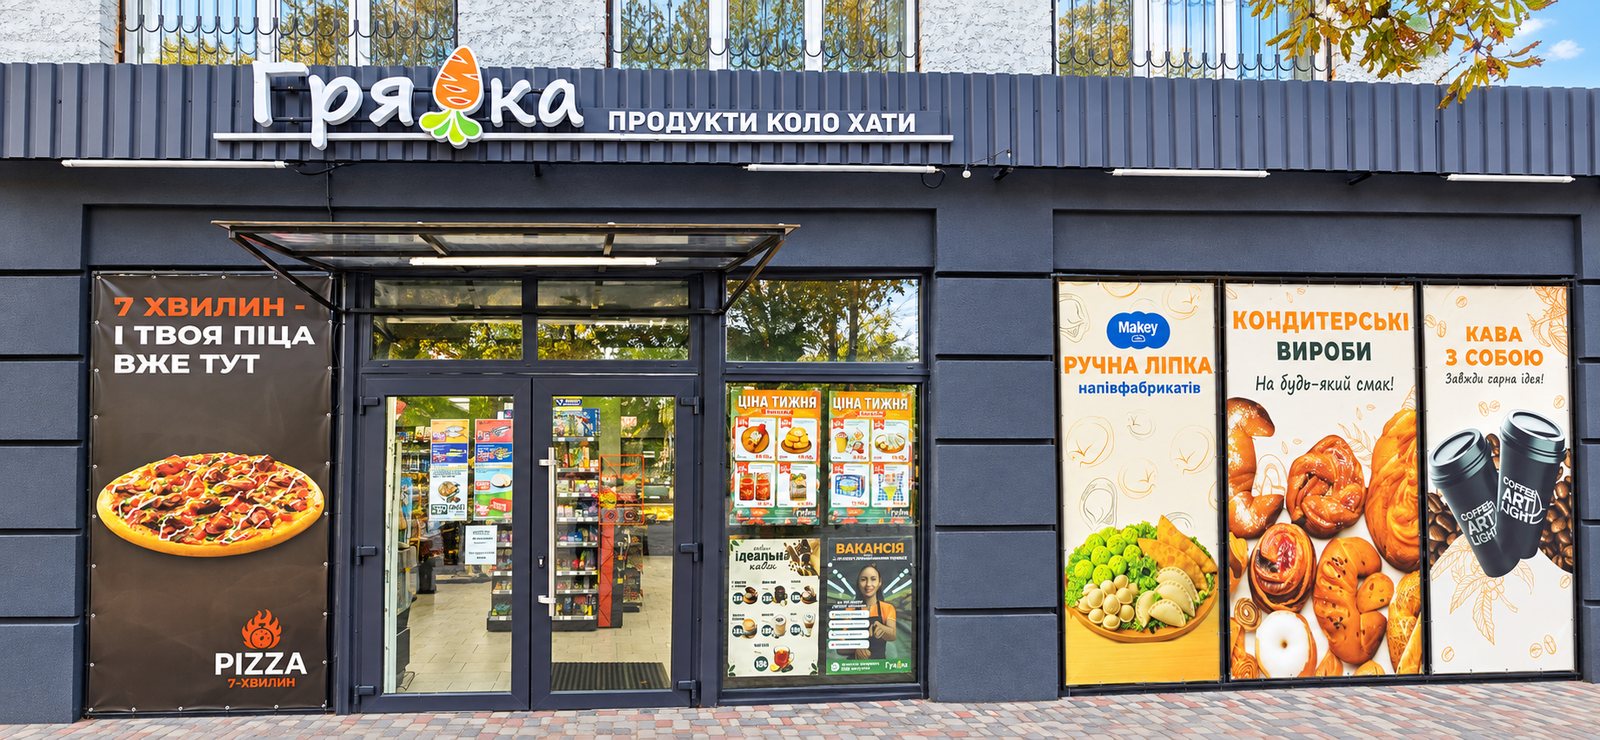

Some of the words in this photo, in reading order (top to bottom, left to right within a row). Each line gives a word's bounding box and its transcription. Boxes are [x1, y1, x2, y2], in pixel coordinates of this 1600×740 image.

[252, 60, 585, 150] Гряка
[608, 111, 757, 133] ПРОДУКТИ
[767, 113, 840, 133] КОЛО
[847, 113, 916, 133] ХАТИ
[114, 297, 134, 317] 7
[144, 297, 285, 317] ХВИЛИН
[1118, 321, 1158, 336] Makey
[1233, 310, 1409, 333] КОНДИТЕРСЬКІ
[114, 325, 123, 345] І
[134, 325, 222, 345] ТВОЯ
[234, 325, 316, 348] ПІЦА
[1465, 326, 1523, 342] КАВА
[1277, 341, 1372, 361] ВИРОБИ
[1445, 348, 1458, 366] З
[1465, 348, 1544, 366] СОБОЮ
[114, 354, 190, 373] ВЖЕ
[200, 354, 260, 373] ТУТ
[1064, 356, 1139, 374] РУЧНА
[1145, 356, 1213, 375] ЛІПКА
[1078, 381, 1201, 396] напівфабрикатів
[1255, 375, 1275, 391] На
[1280, 374, 1351, 395] будь-який
[1356, 376, 1394, 391] смак!
[1445, 372, 1484, 385] Завжди
[1487, 375, 1517, 387] гарна
[1521, 372, 1545, 385] ідея!
[738, 395, 768, 409] ЦІНА
[772, 395, 817, 409] ТИЖНЯ
[833, 397, 861, 410] ЦІНА
[864, 397, 908, 410] ТИЖНЯ
[1503, 476, 1537, 498] COFFEE
[1502, 487, 1536, 513] ART
[1460, 500, 1493, 521] COFFEE
[1468, 508, 1494, 535] ART
[835, 542, 904, 554] ВАКАНСІЯ
[215, 652, 307, 676] PIZZA
[227, 677, 296, 689] 7-ХВИЛИН
